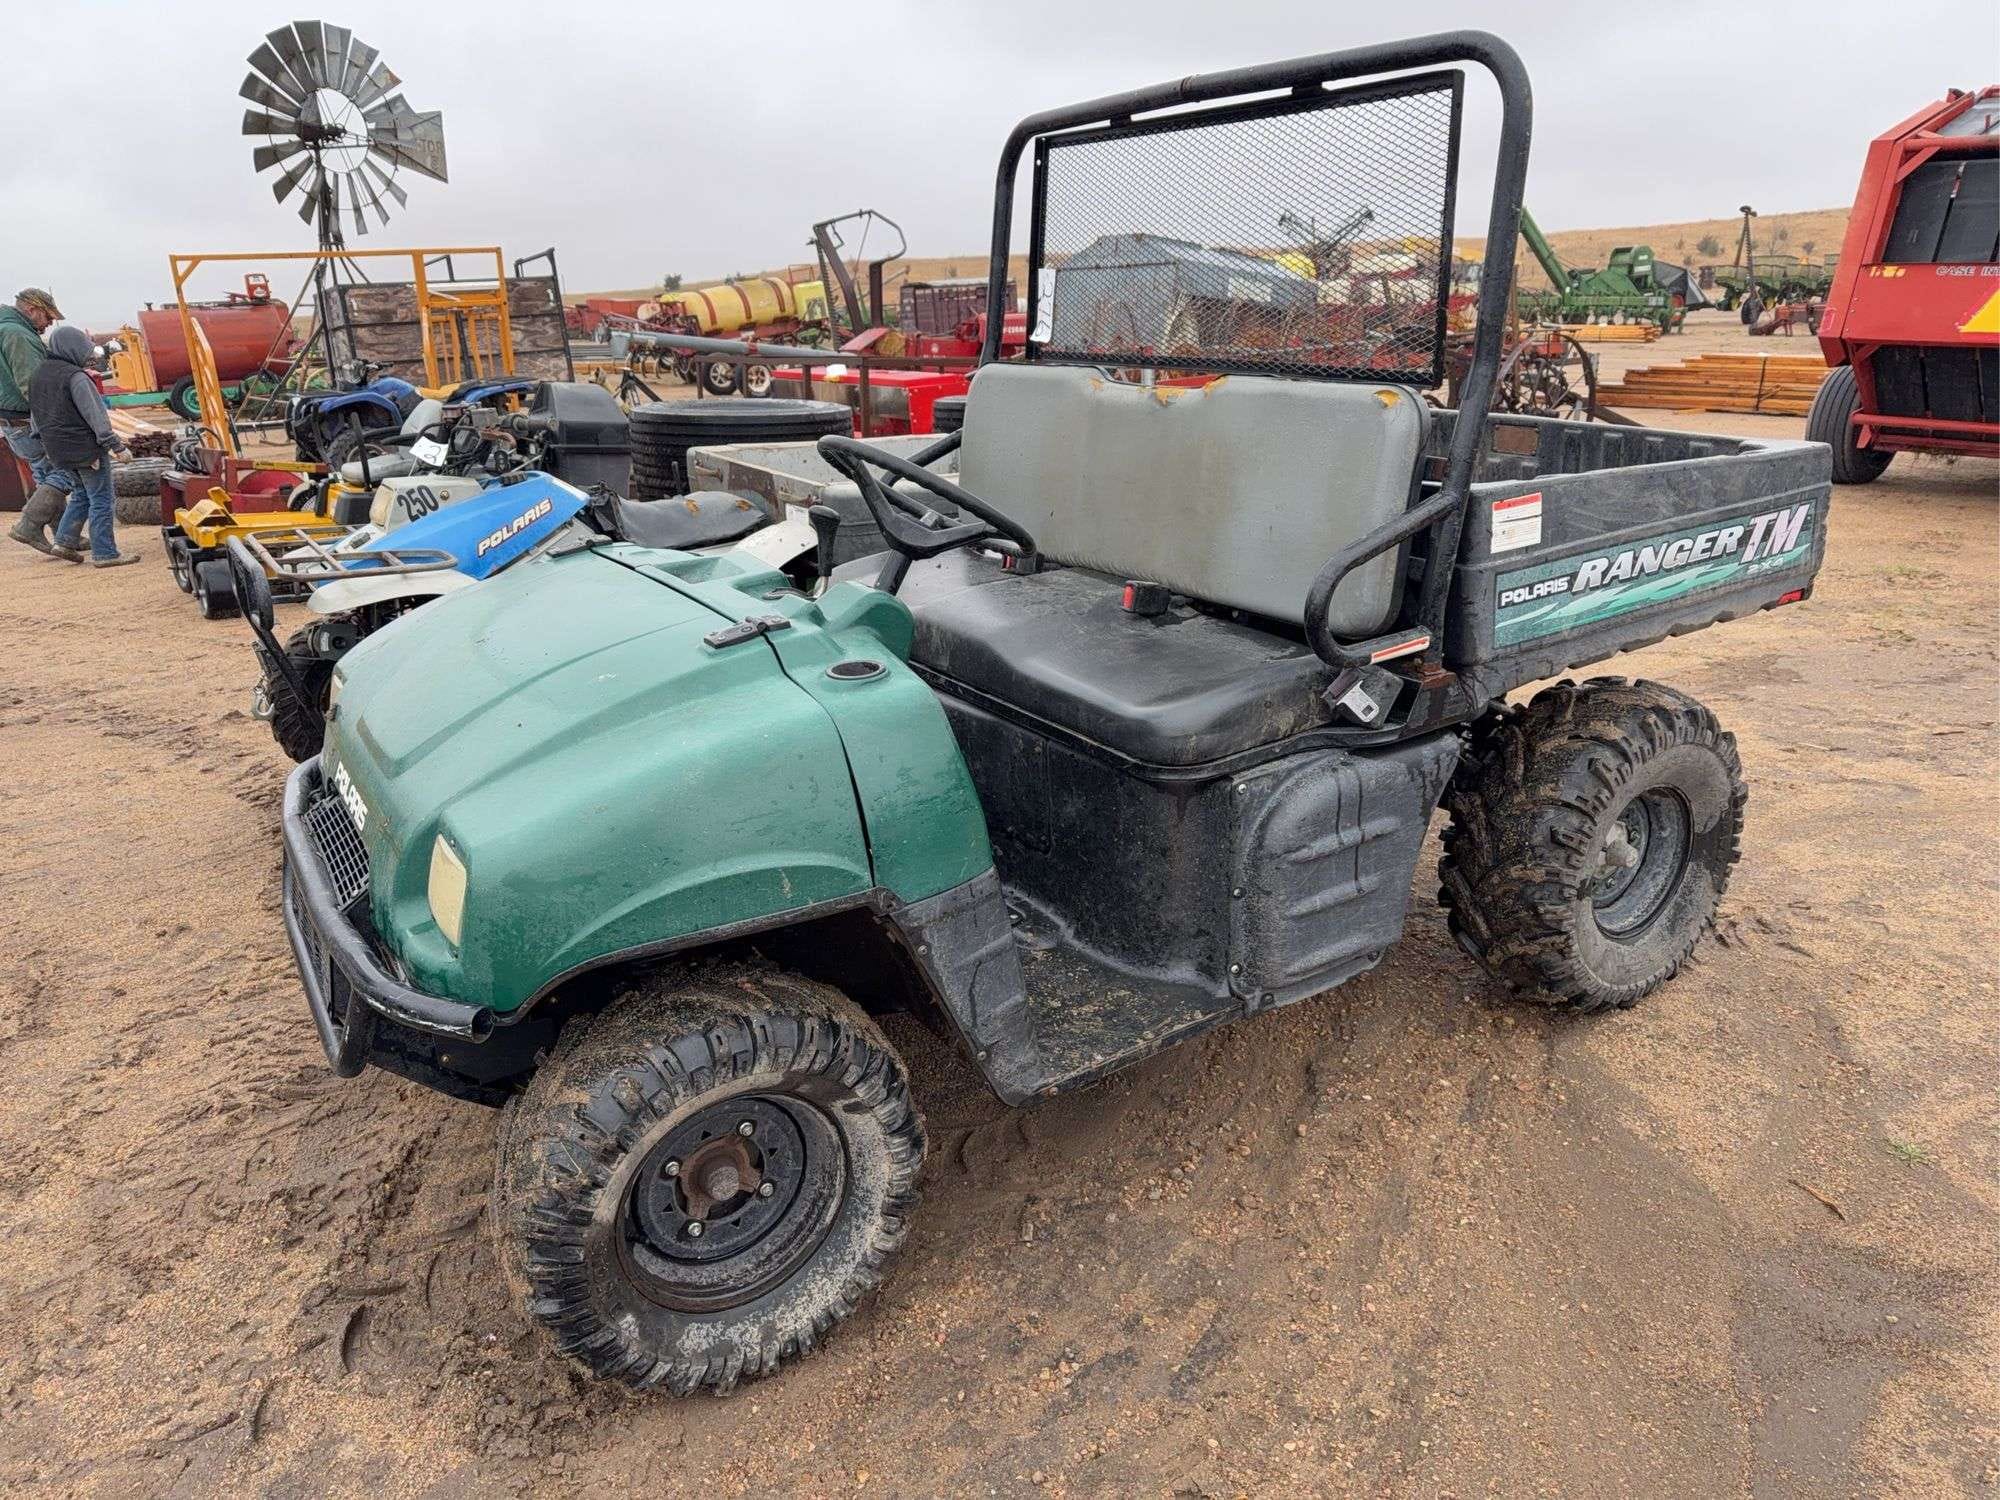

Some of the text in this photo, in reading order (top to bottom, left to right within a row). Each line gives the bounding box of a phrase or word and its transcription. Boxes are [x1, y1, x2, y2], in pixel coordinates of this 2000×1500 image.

[1936, 265, 1976, 277] CASE
[397, 485, 439, 522] 250
[477, 497, 553, 558] POLARIS
[1500, 576, 1571, 607] POLARIS
[1571, 524, 1746, 593] RANGER
[334, 760, 369, 832] POLARIS
